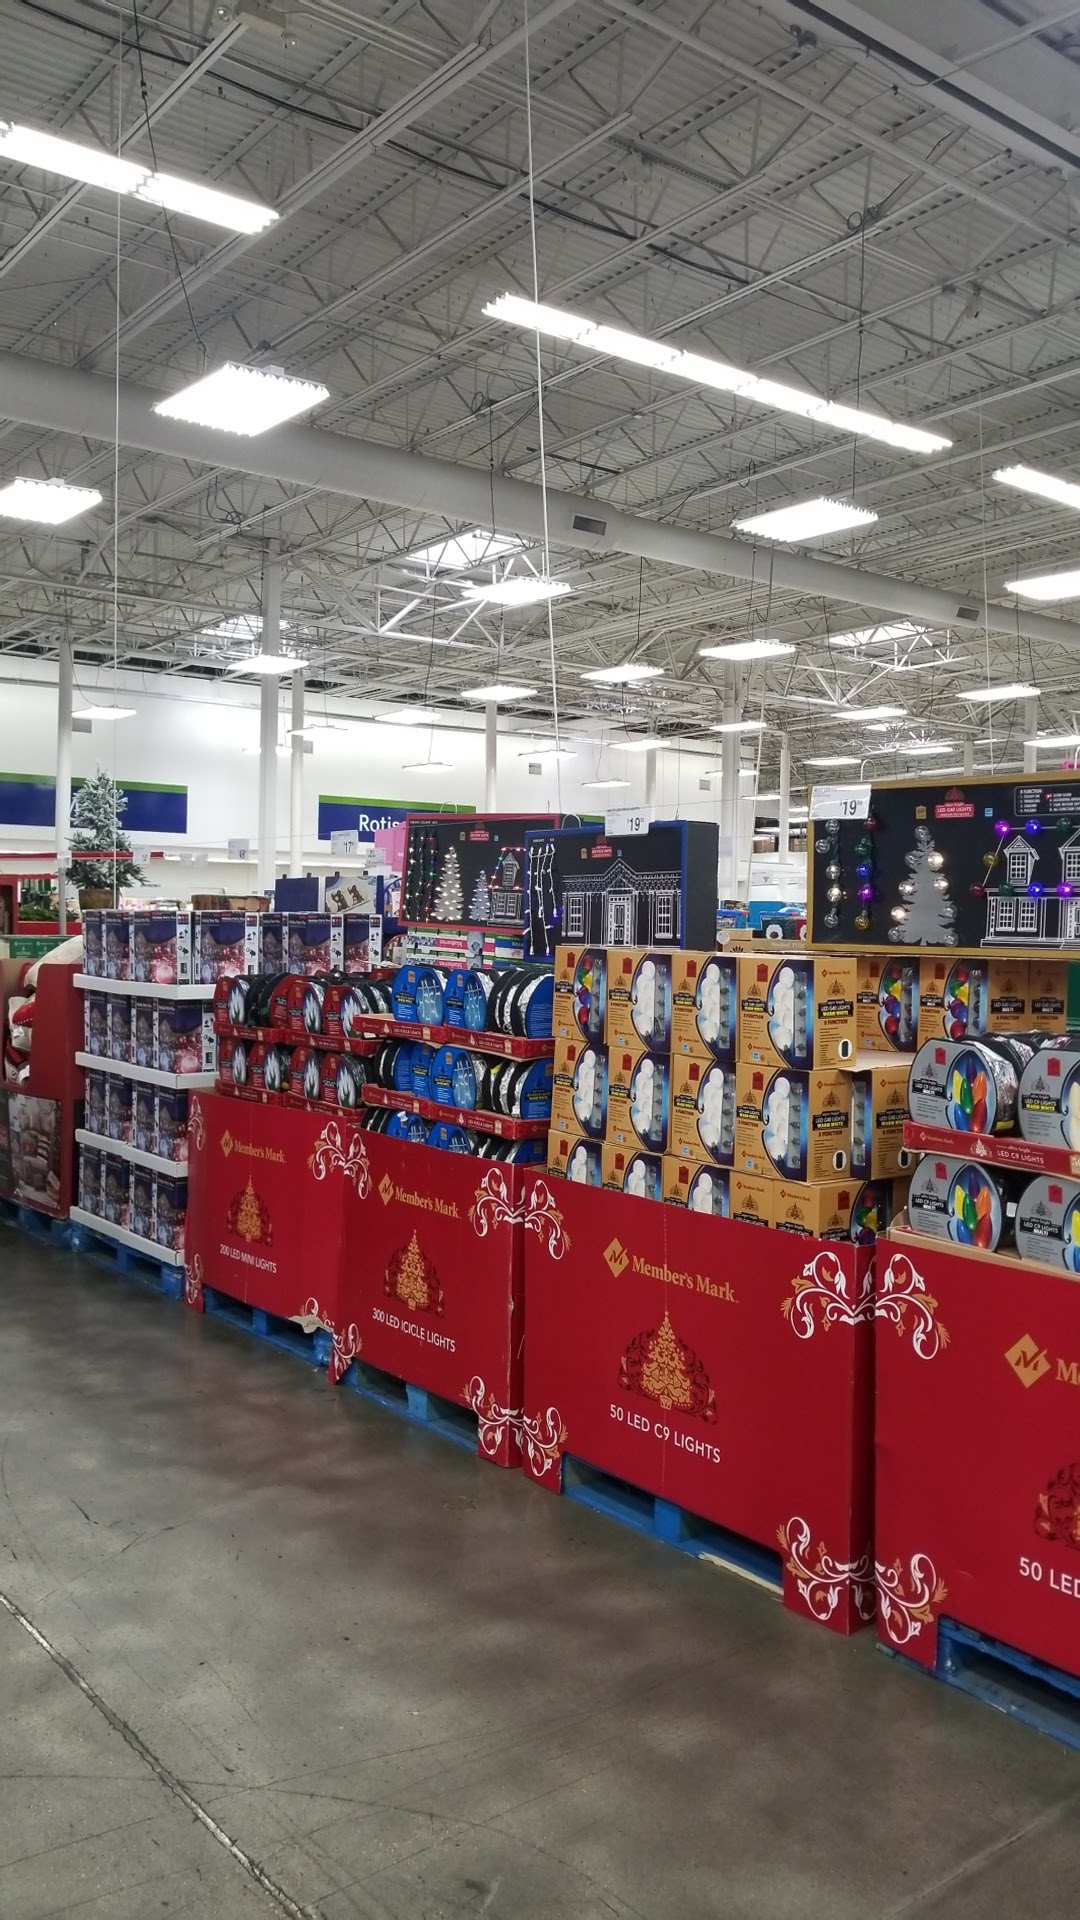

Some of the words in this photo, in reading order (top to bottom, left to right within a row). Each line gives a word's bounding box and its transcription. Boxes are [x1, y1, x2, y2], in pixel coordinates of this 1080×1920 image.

[929, 1085, 943, 1093] LIGHTS
[235, 1140, 265, 1158] Member's
[265, 1148, 285, 1163] Mark
[998, 1150, 1010, 1158] LED
[1021, 1154, 1045, 1165] LIGHTS
[395, 1187, 434, 1211] Member's
[434, 1198, 459, 1219] Mark
[930, 1200, 944, 1208] LIGHTS
[1034, 1228, 1049, 1236] MULTI
[1042, 1225, 1059, 1234] LIGHTS
[220, 1244, 229, 1256] 200
[230, 1247, 241, 1260] LED
[241, 1253, 255, 1266] MINI
[255, 1258, 277, 1274] LIGHTS
[632, 1255, 694, 1290] Member's
[696, 1274, 736, 1303] Mark
[372, 1307, 386, 1323] 300
[386, 1314, 400, 1330] LED
[401, 1319, 425, 1340] ICICLE
[427, 1330, 456, 1352] LIGHTS
[610, 1404, 624, 1421] 50
[627, 1411, 651, 1432] LED
[654, 1423, 670, 1441] C9
[674, 1431, 721, 1464] LIGHTS
[1020, 1557, 1042, 1582] 50
